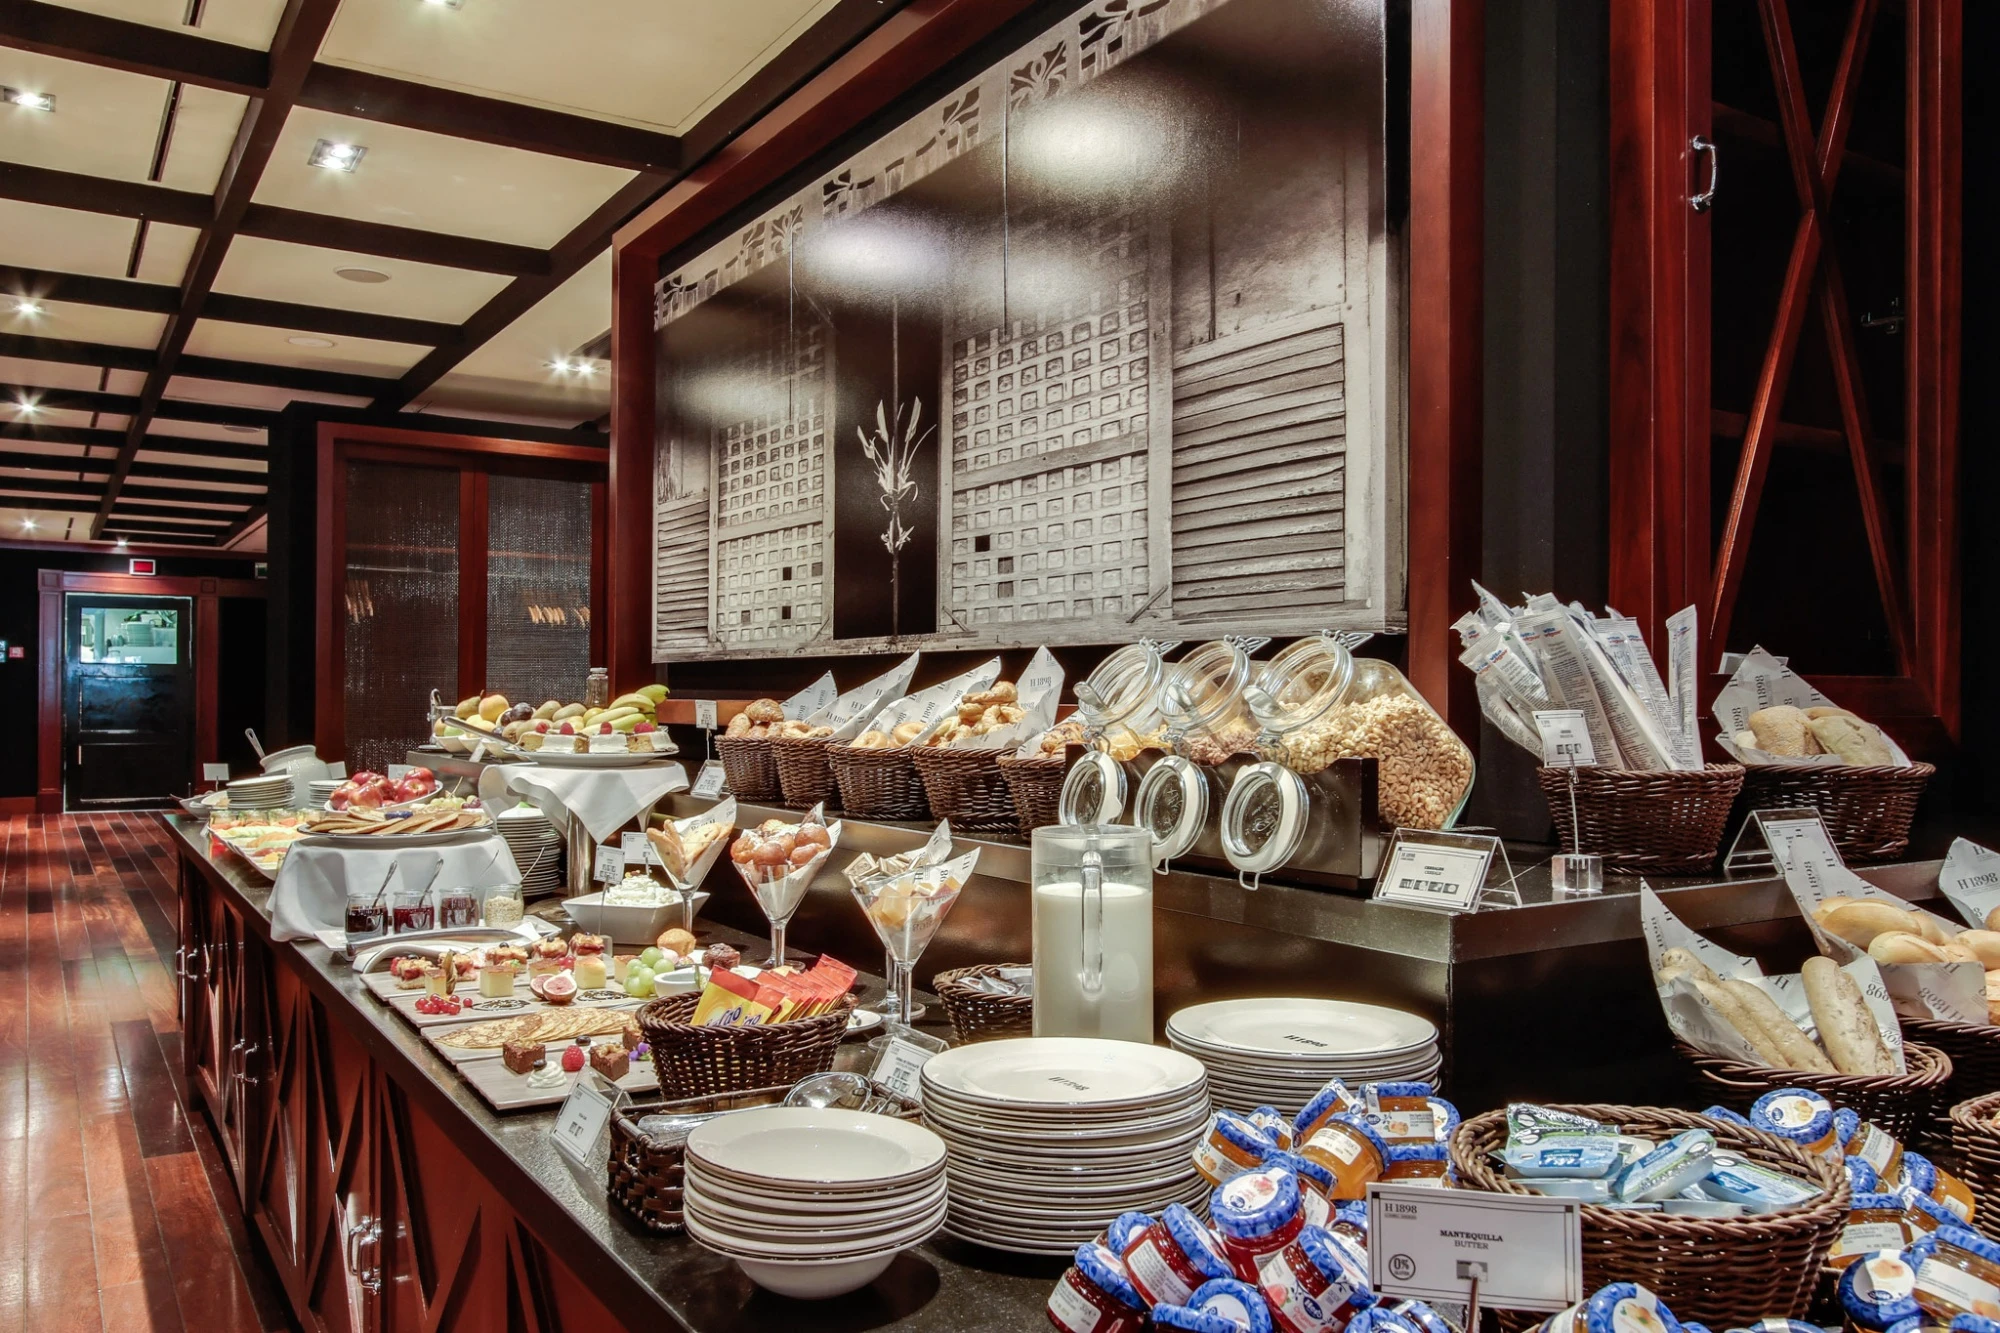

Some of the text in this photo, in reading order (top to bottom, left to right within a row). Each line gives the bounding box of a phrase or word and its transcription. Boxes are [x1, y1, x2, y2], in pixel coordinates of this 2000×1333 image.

[1755, 675, 1767, 699] 1898
[1732, 707, 1744, 731] 1898
[1972, 845, 1985, 856] H
[1957, 872, 1998, 890] H 1898
[1918, 987, 1950, 1014] 1898
[1384, 1203, 1417, 1214] H 1898
[1440, 1230, 1503, 1242] MANTEQUILLA
[1454, 1240, 1489, 1250] BUTTER
[1394, 1257, 1409, 1270] 0%
